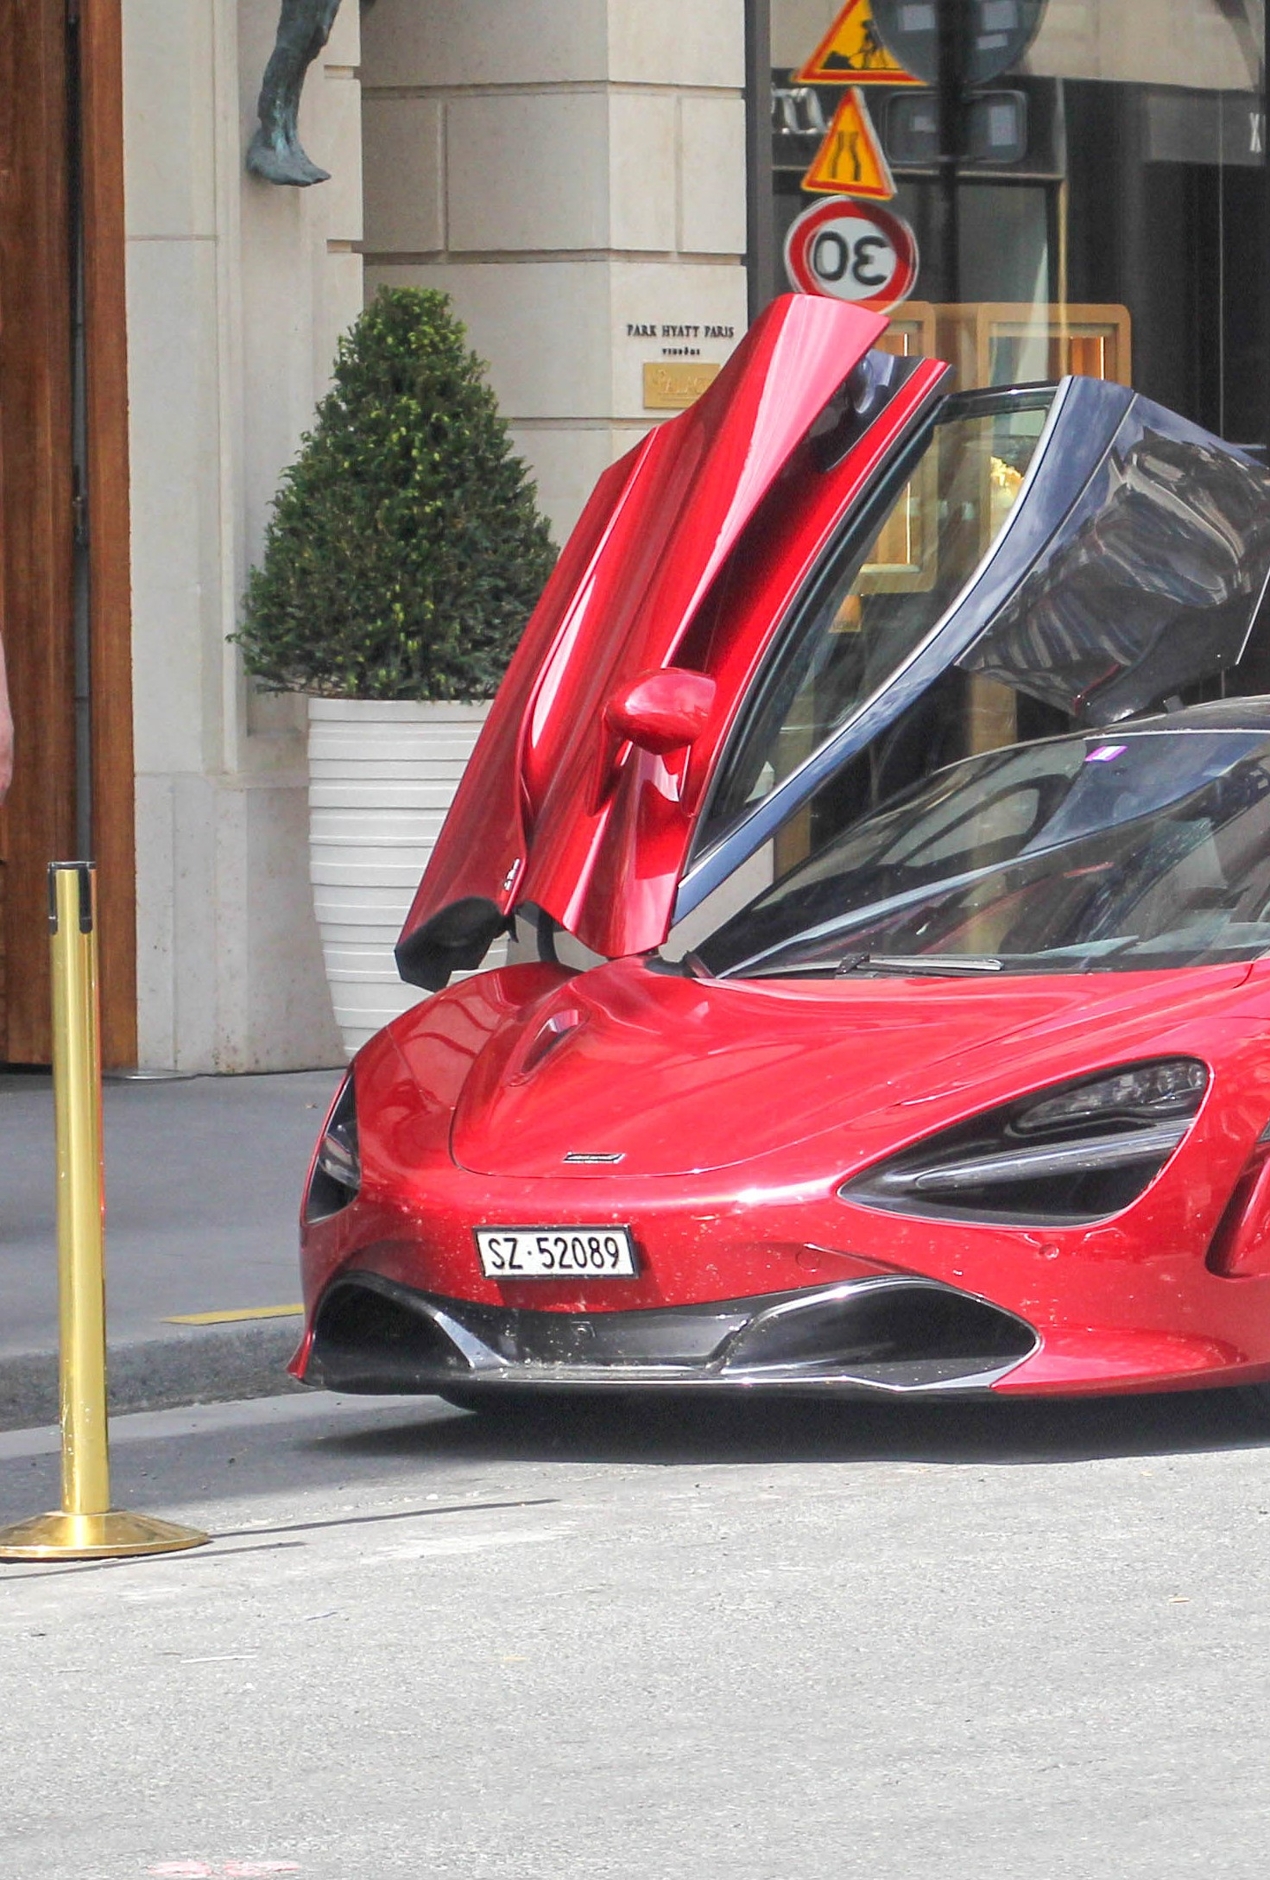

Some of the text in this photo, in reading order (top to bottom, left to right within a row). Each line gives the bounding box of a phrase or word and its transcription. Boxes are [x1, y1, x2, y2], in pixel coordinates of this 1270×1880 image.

[627, 324, 734, 338] PARK HYATT PARIS
